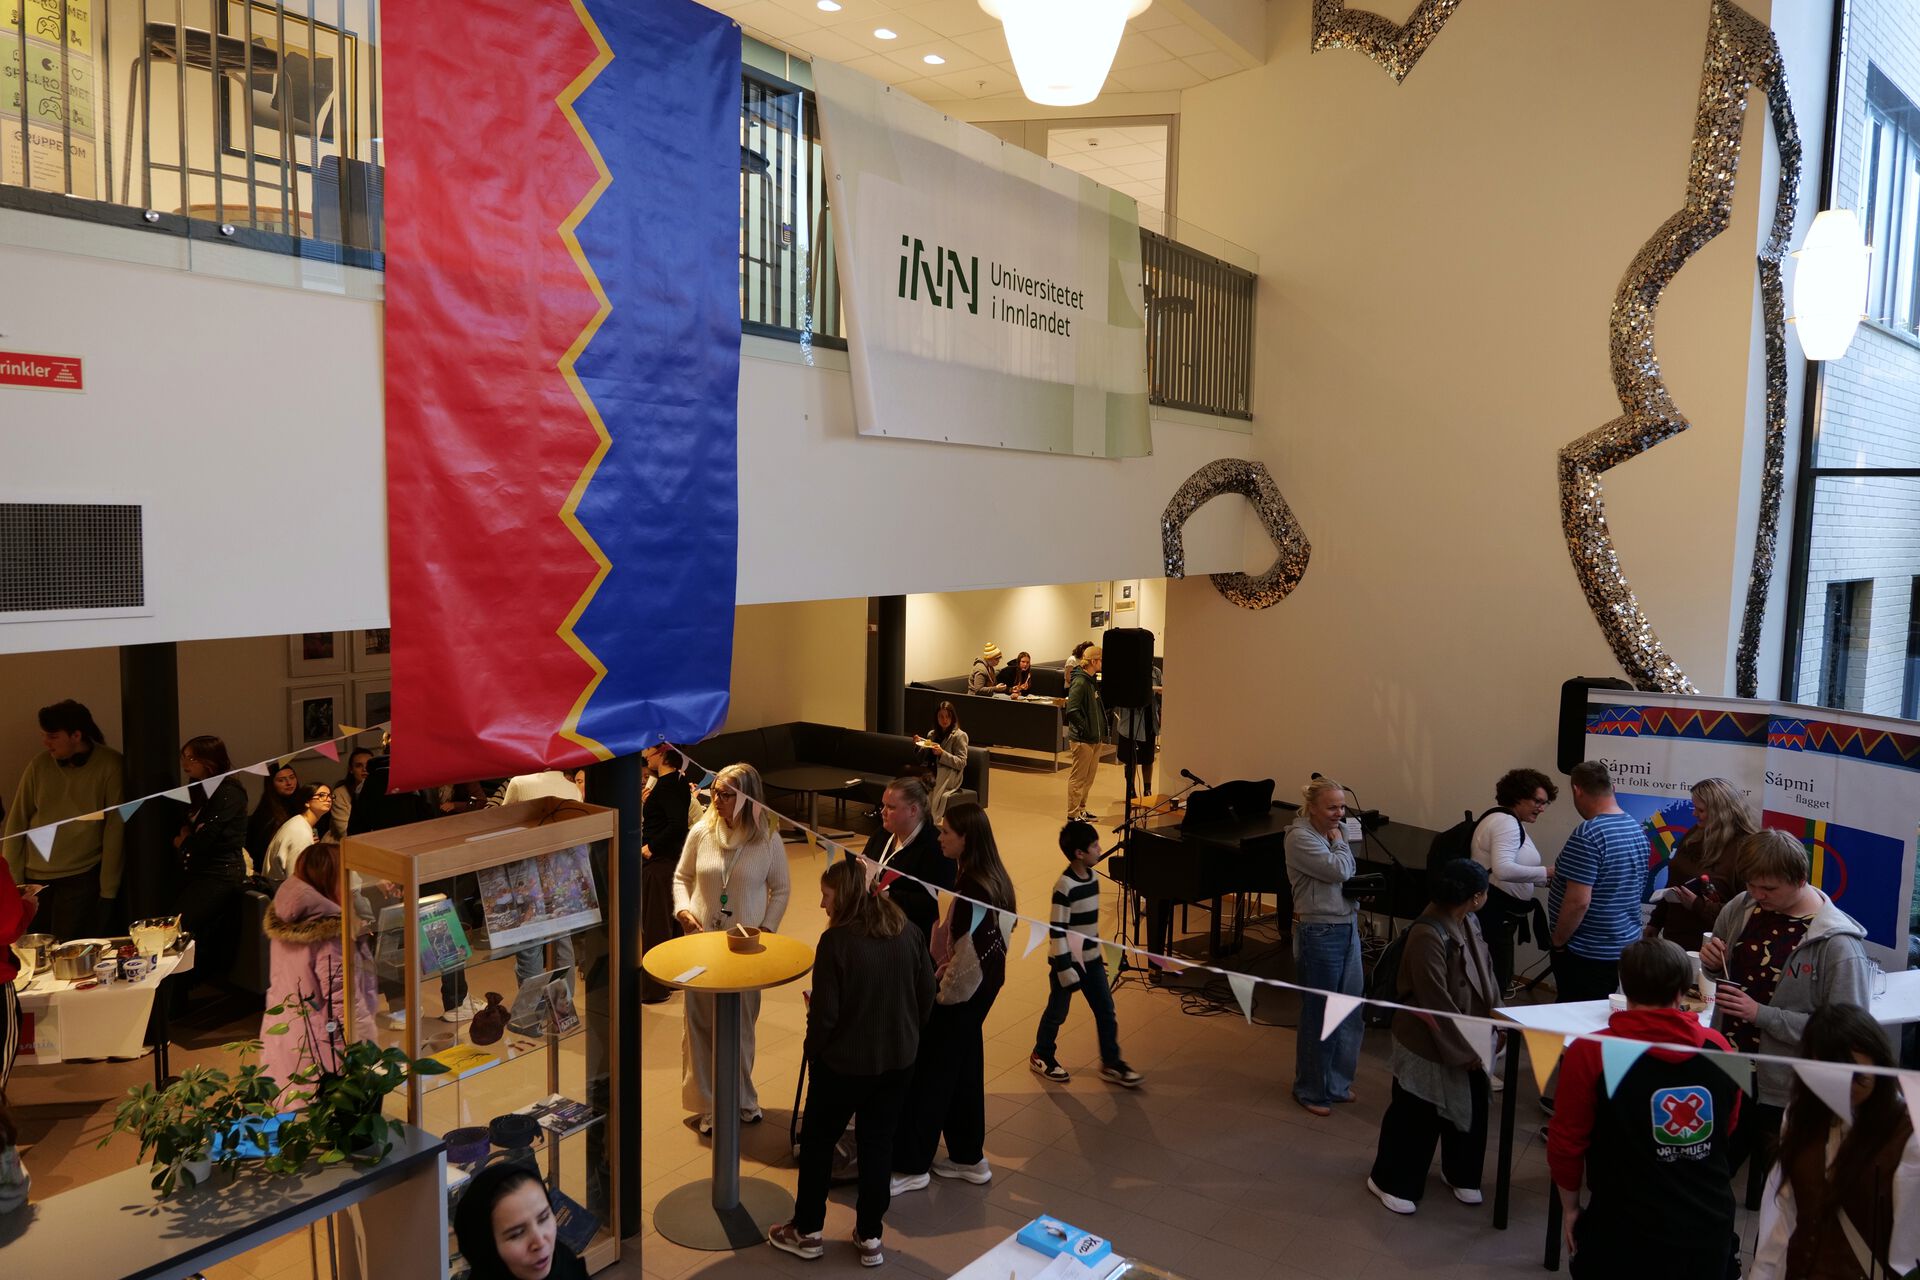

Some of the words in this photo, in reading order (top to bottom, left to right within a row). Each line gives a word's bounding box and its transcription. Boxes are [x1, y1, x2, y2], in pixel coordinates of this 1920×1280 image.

[991, 262, 1084, 311] Universitetet
[992, 296, 996, 319] i
[1001, 298, 1071, 338] Innlandet
[1599, 758, 1651, 775] Sápmi
[1629, 777, 1649, 787] folk
[1652, 782, 1677, 791] over
[1765, 771, 1814, 793] Sápmi
[1796, 794, 1830, 809] flagget
